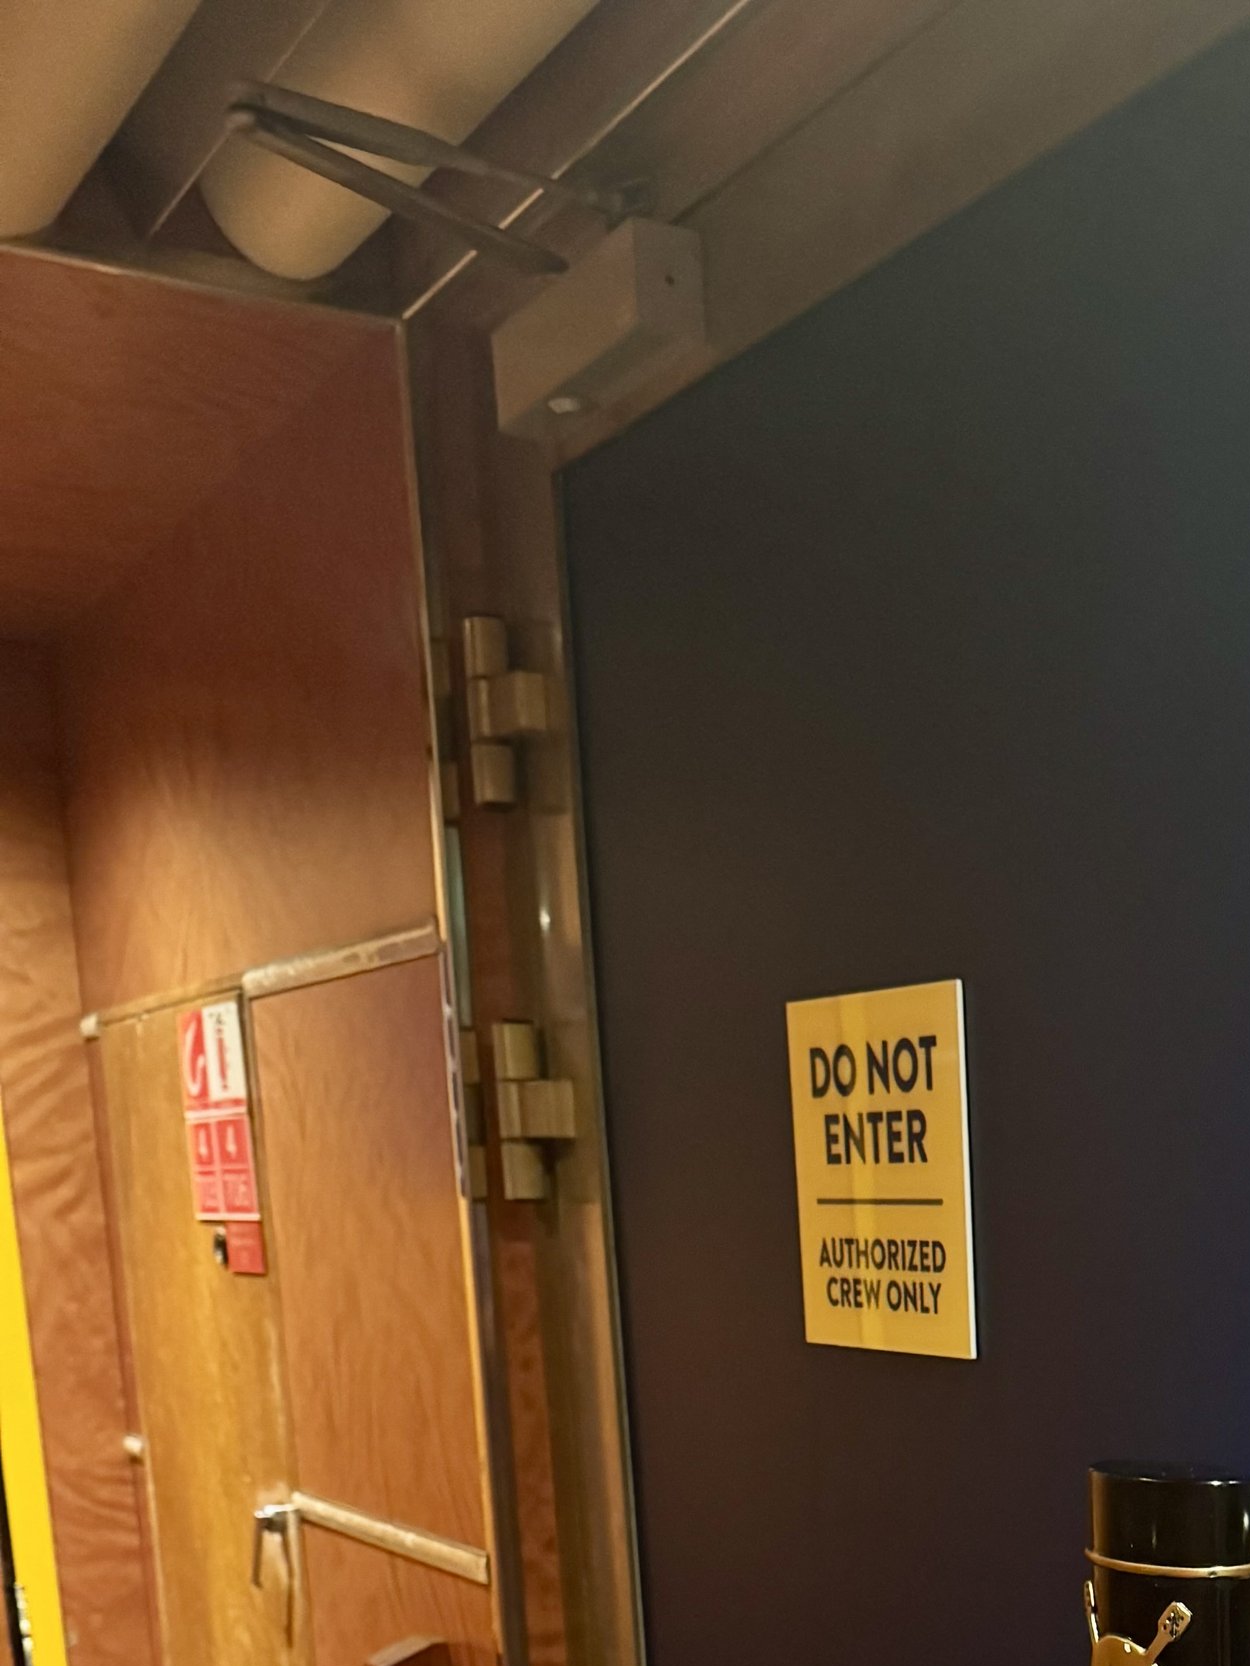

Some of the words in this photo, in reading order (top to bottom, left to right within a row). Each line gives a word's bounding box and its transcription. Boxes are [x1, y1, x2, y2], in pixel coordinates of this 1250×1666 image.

[809, 1044, 856, 1098] DO
[866, 1035, 937, 1095] NOT
[824, 1108, 928, 1165] ENTER
[819, 1237, 946, 1273] AUTHORIZED
[826, 1277, 881, 1309] CREW
[886, 1280, 942, 1314] ONLY
